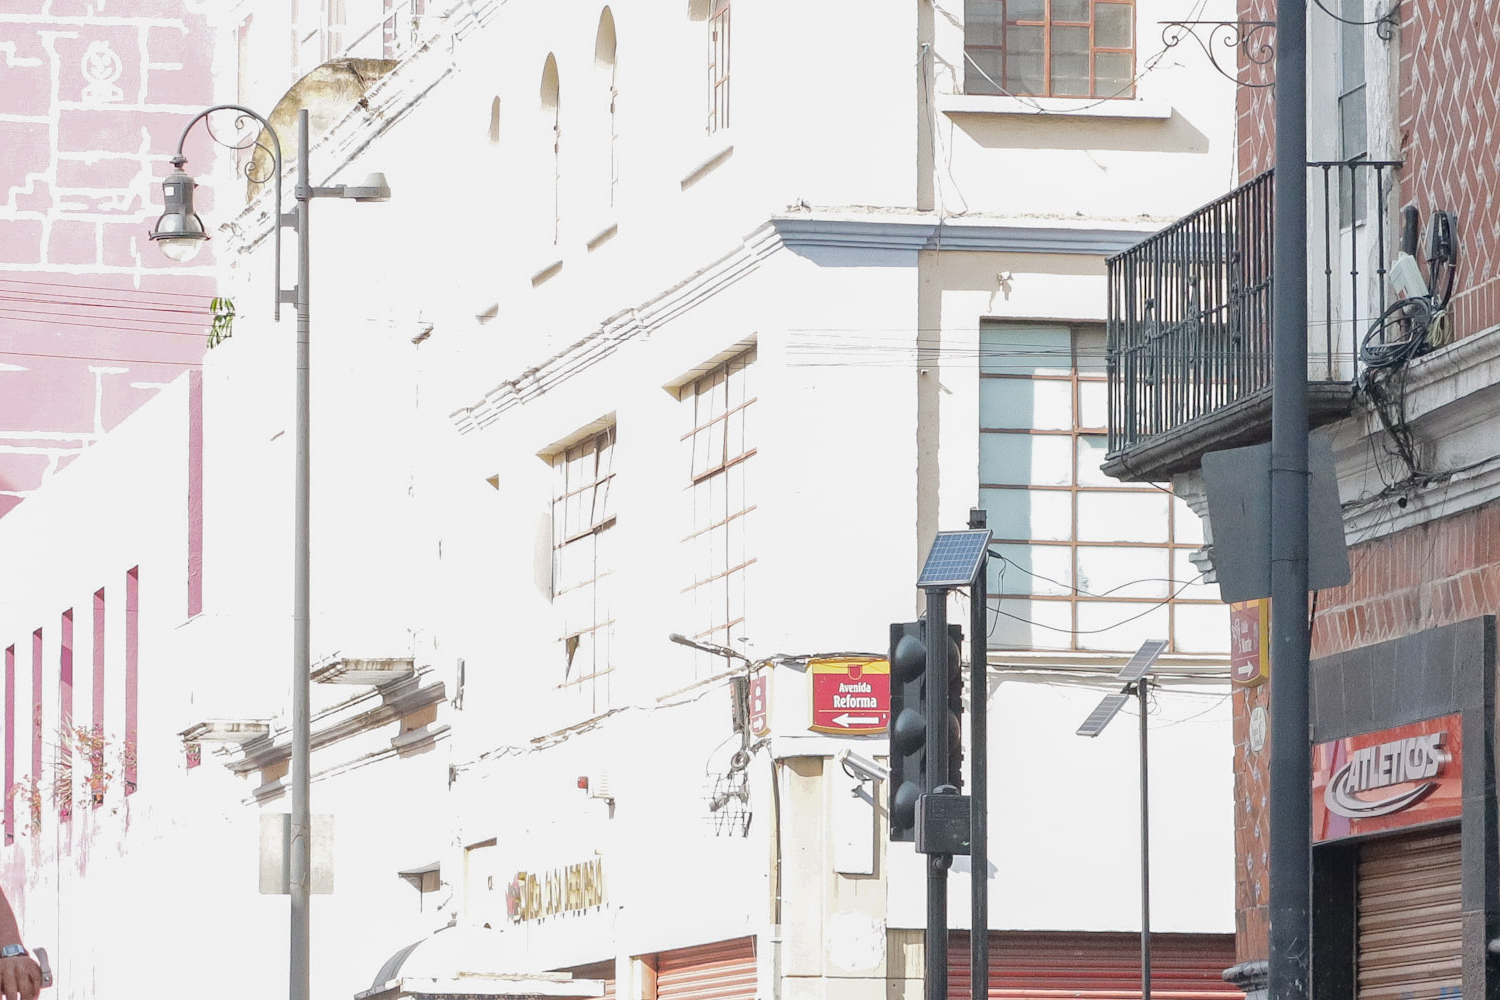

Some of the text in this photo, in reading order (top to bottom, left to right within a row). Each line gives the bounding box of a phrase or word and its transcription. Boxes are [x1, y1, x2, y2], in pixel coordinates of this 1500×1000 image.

[838, 682, 872, 694] Avenida
[833, 694, 878, 709] Reforma
[1345, 732, 1443, 794] ATLETICOS
